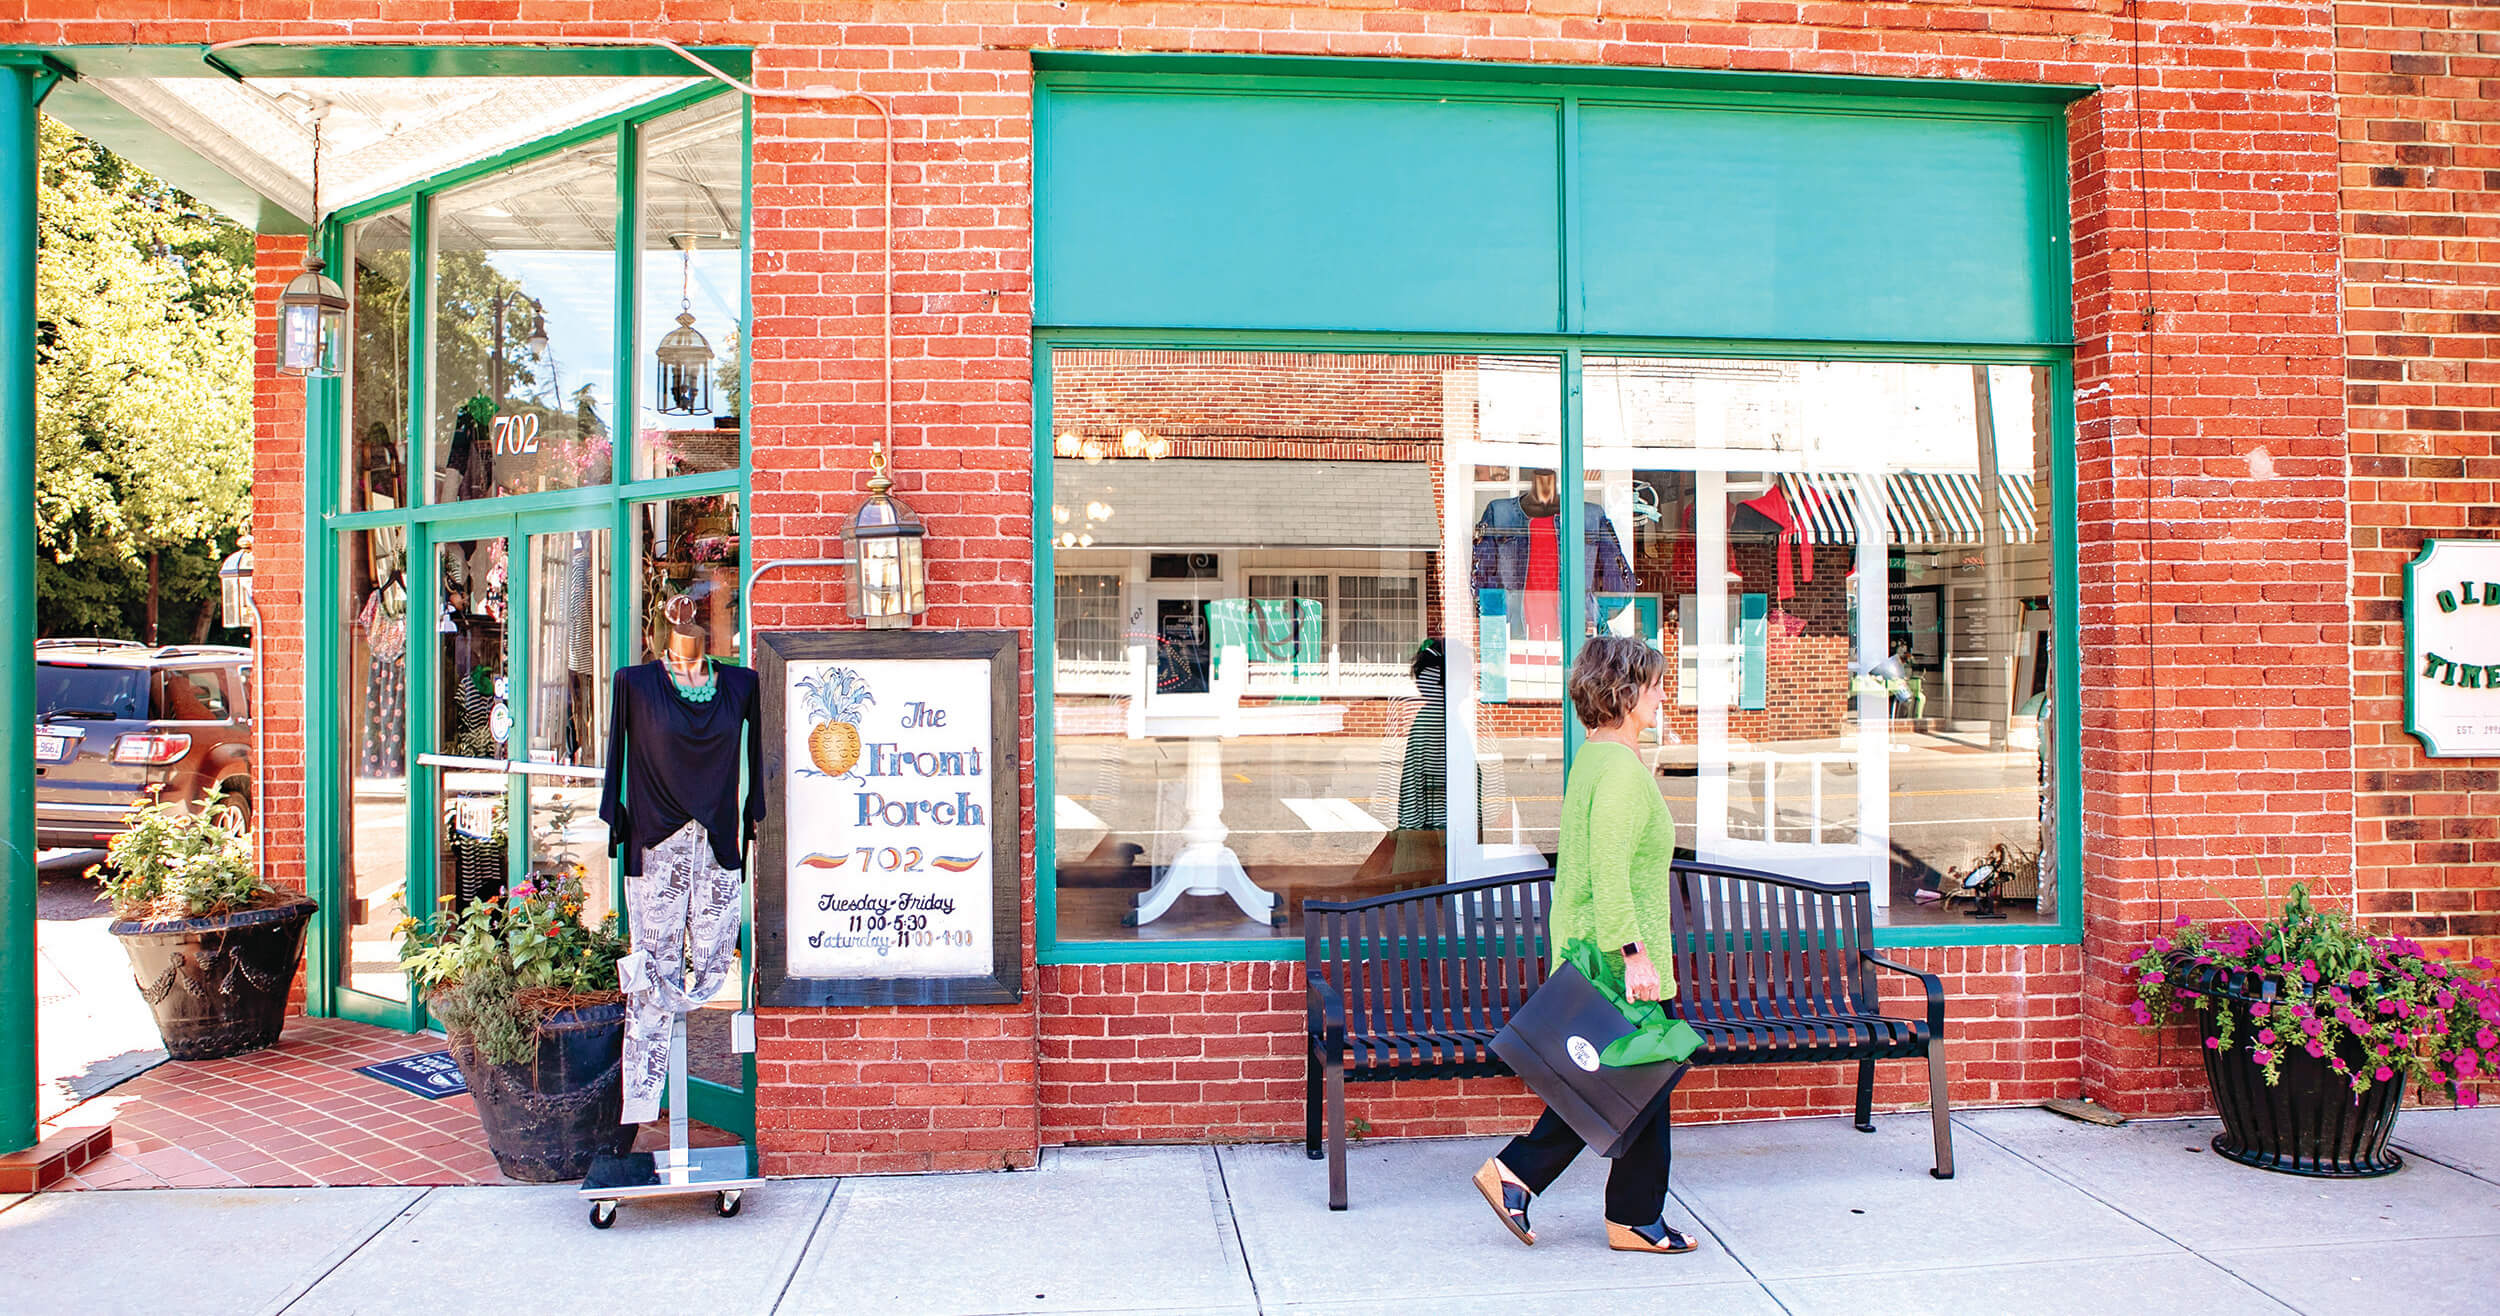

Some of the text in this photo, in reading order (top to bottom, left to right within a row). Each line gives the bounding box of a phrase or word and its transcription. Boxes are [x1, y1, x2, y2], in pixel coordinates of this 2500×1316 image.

[493, 413, 539, 456] 702
[2436, 581, 2500, 613] OLD
[2422, 652, 2500, 689] TIME
[901, 701, 947, 729] The
[865, 743, 983, 778] Front
[853, 792, 986, 828] Porch
[856, 846, 924, 873] 702
